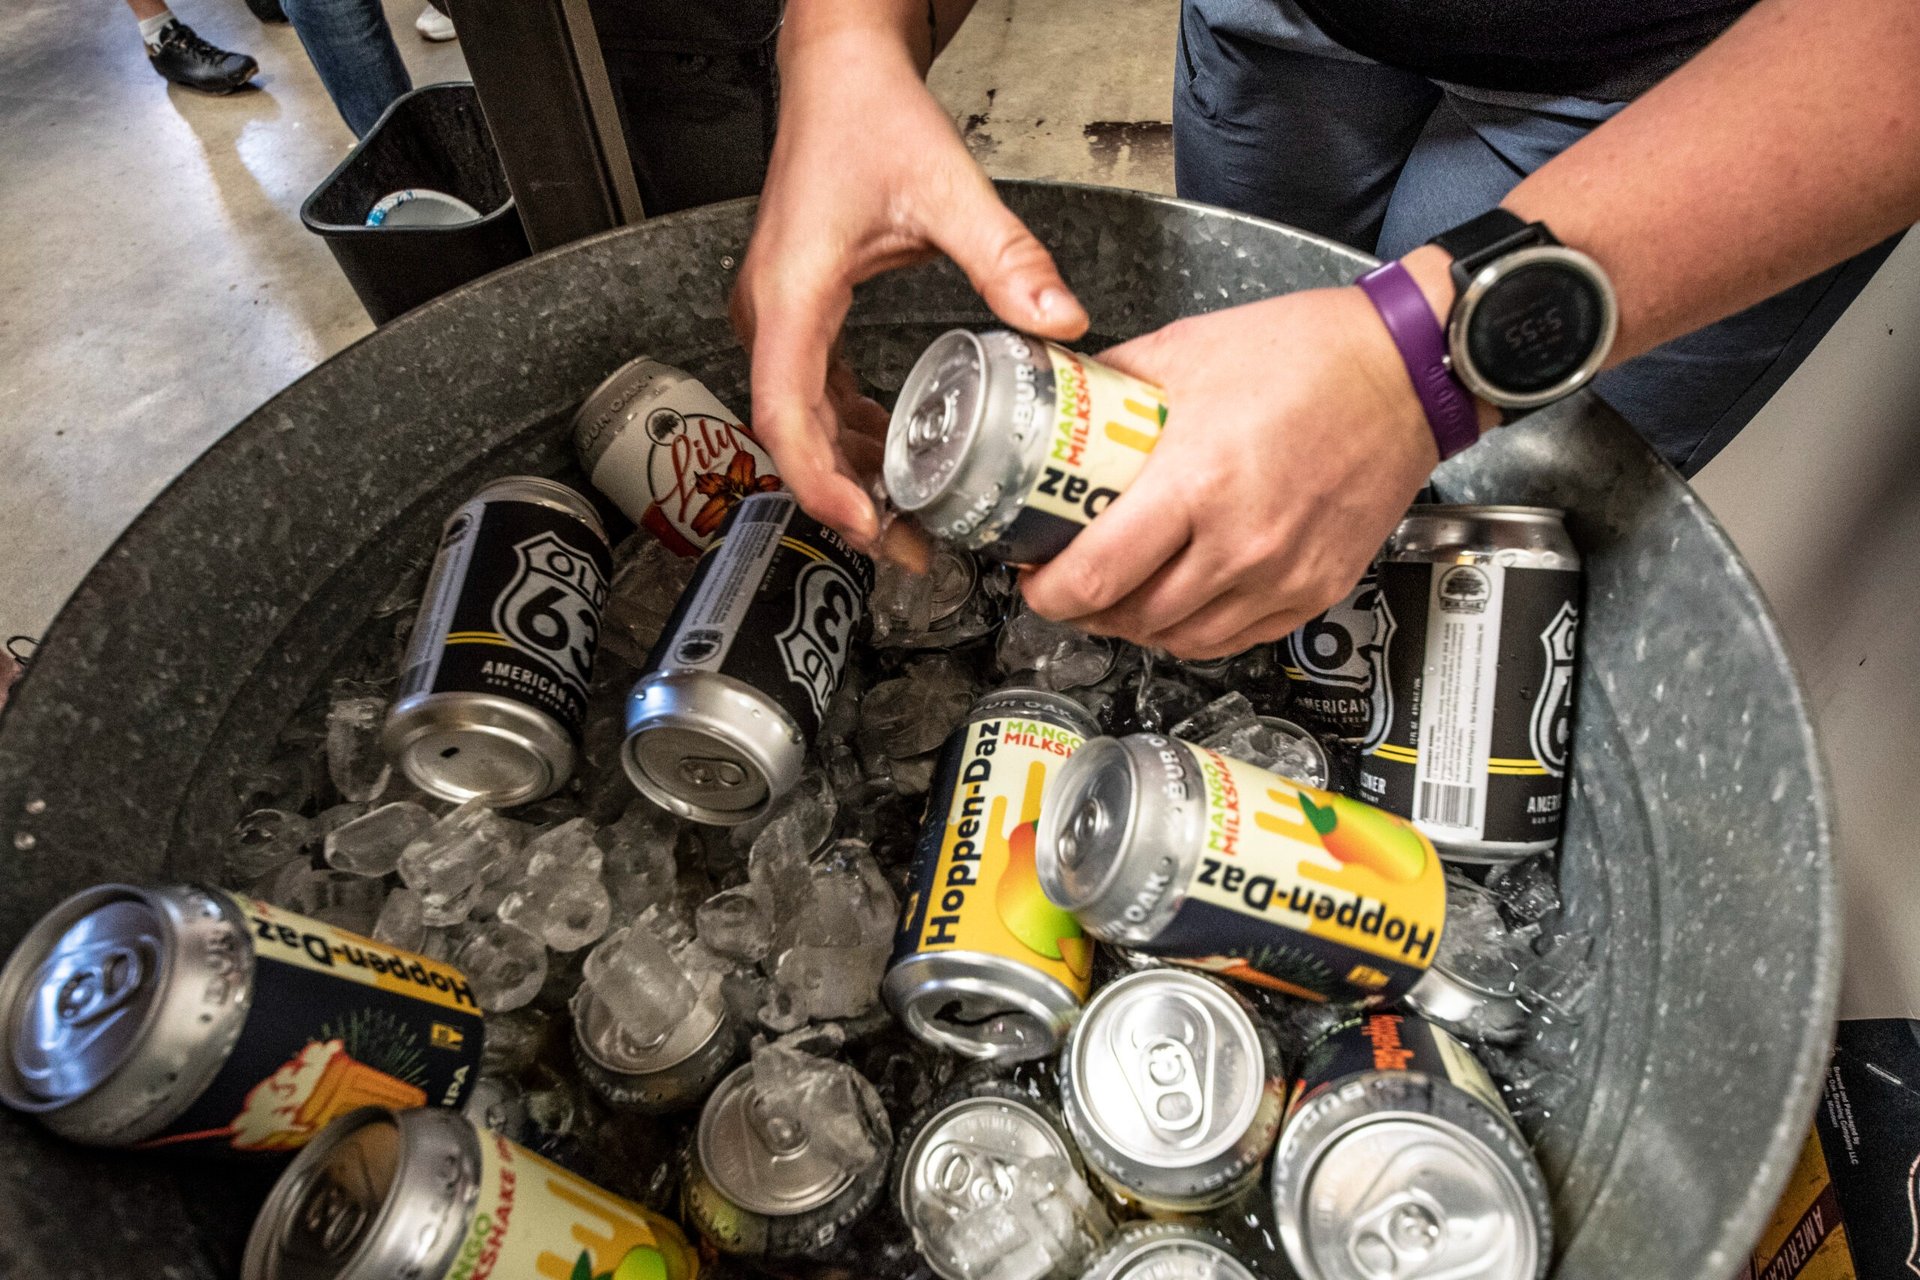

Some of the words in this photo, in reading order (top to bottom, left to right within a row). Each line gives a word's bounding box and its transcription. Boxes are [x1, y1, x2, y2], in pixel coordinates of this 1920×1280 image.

[1051, 367, 1077, 462] MANGO
[653, 417, 746, 523] Lily
[481, 660, 568, 700] AMERICAN
[517, 586, 598, 685] 63
[1006, 720, 1083, 752] MANGO
[925, 720, 1001, 947] Hoppen-Daz
[1204, 763, 1225, 851] MANGO
[1196, 857, 1435, 960] Hoppen-Daz
[252, 917, 478, 1008] Hoppen-Daz
[441, 1065, 471, 1106] IPA
